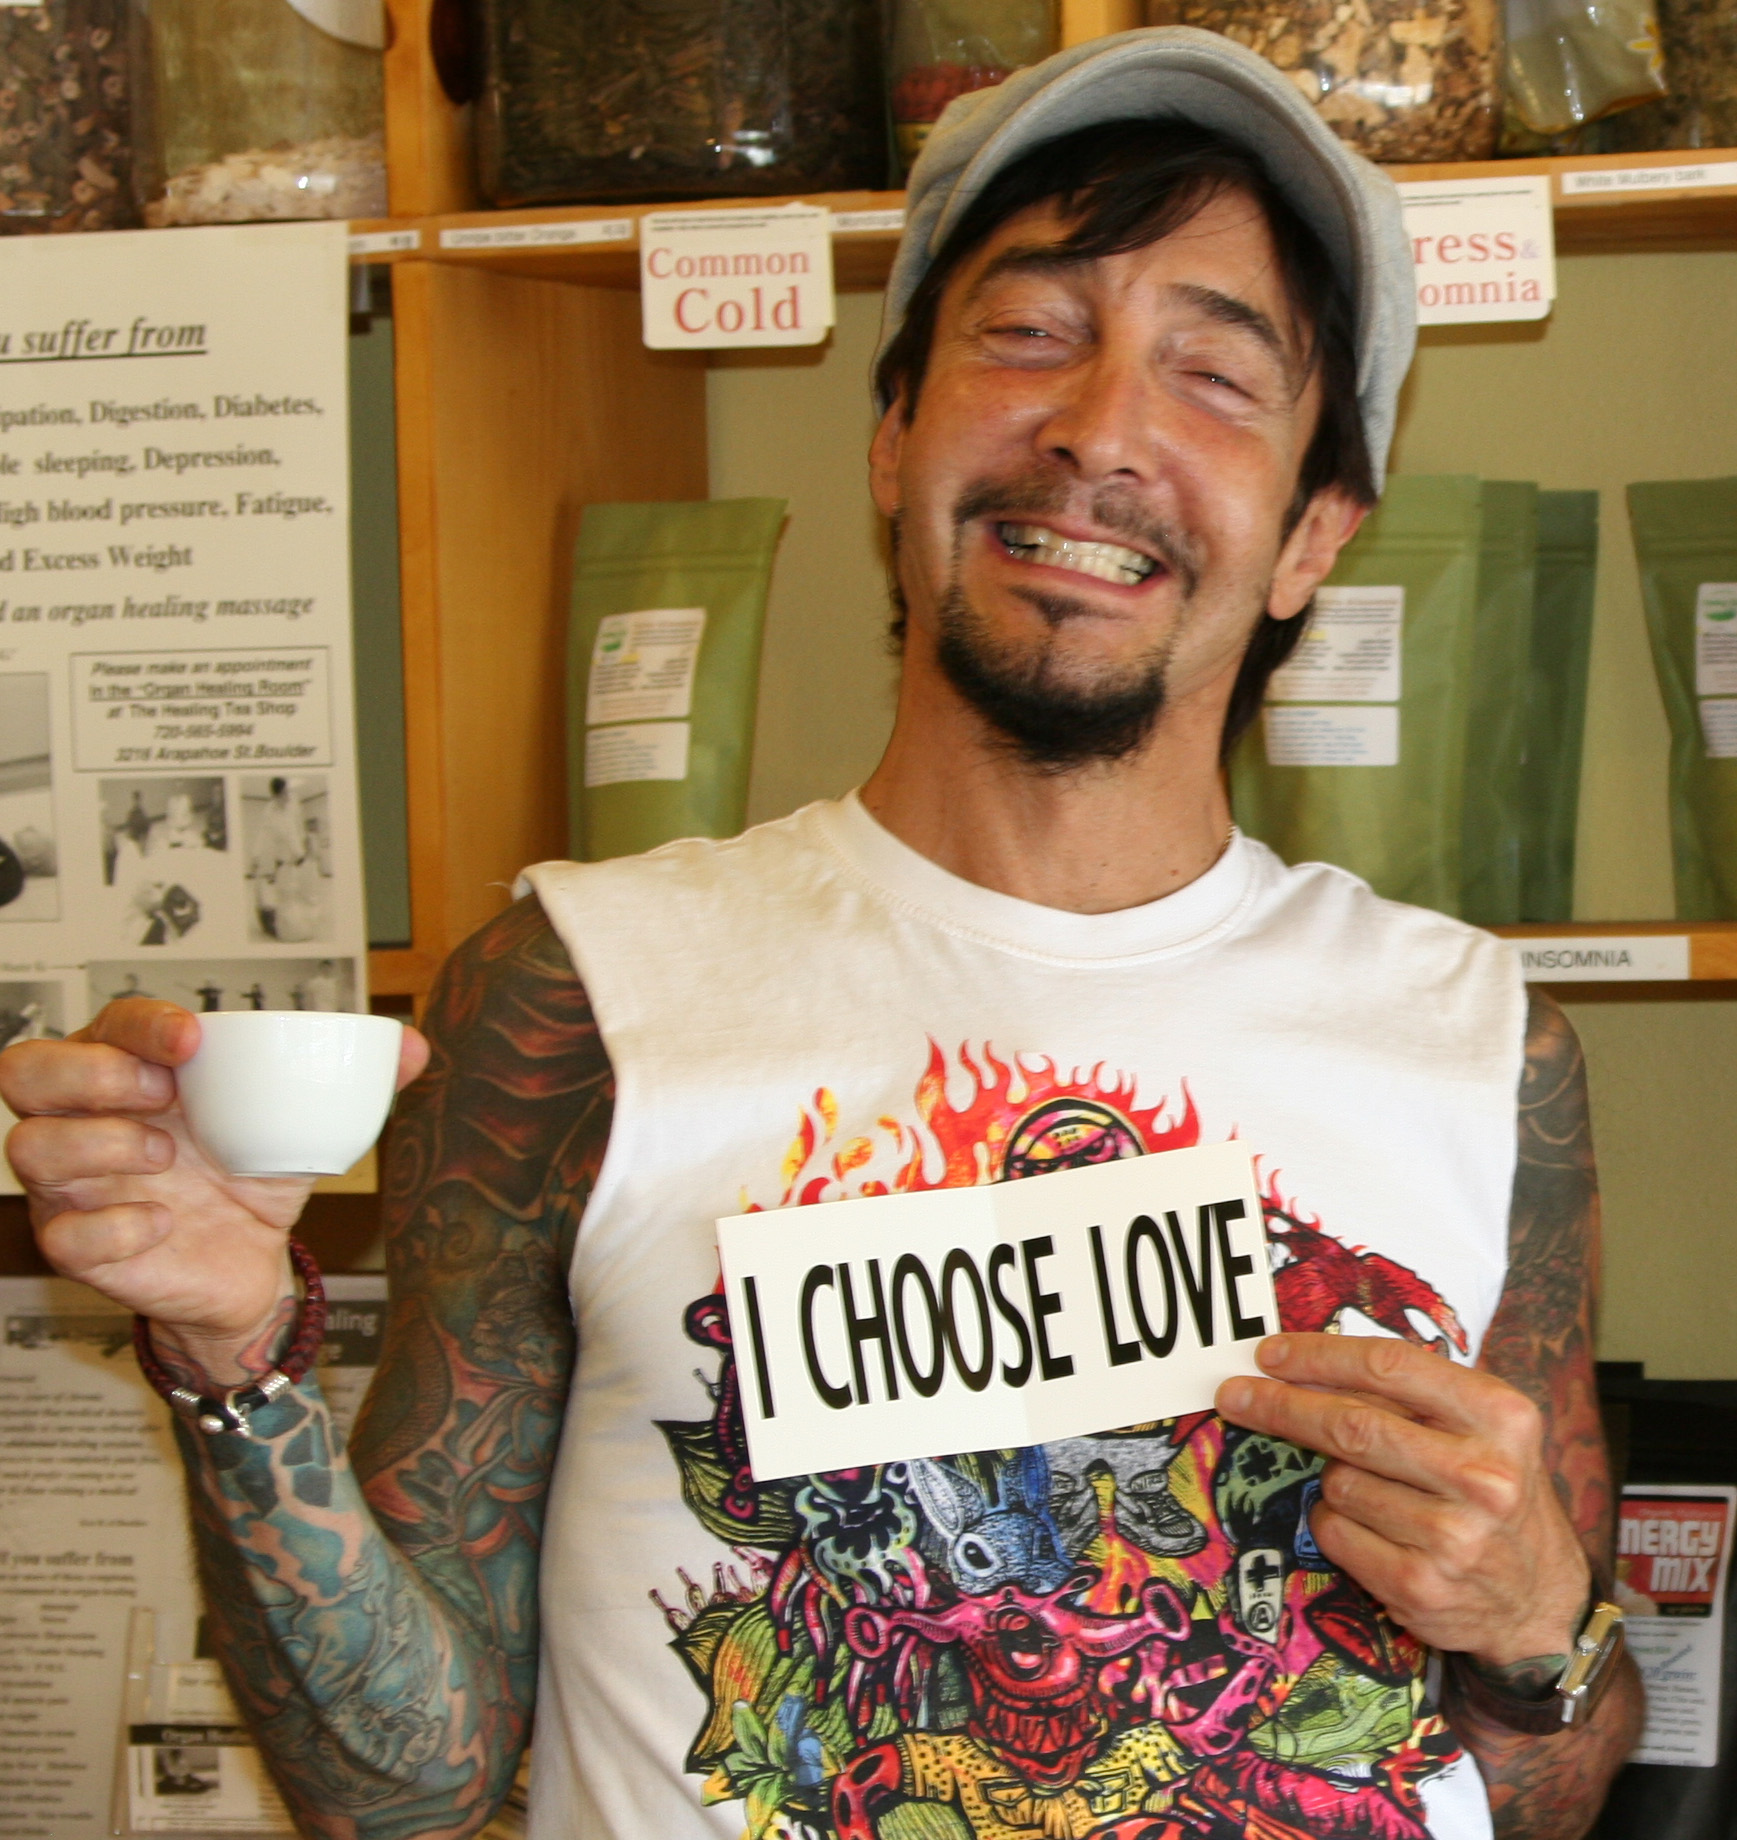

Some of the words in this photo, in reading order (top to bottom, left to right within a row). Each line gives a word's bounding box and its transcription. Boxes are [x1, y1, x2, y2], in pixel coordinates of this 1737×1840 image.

[647, 247, 810, 280] Common
[1413, 231, 1518, 264] ress
[1418, 271, 1540, 306] omnia
[674, 285, 802, 334] Cold
[22, 319, 118, 356] suffer
[128, 316, 206, 355] from
[89, 398, 205, 427] Digestion,
[213, 394, 323, 420] Diabetes,
[143, 444, 281, 472] Depression,
[47, 498, 112, 521] blood
[120, 497, 230, 525] pressure,
[236, 491, 333, 519] Fatigue,
[23, 548, 99, 571] Excess
[107, 542, 192, 571] Weight
[12, 606, 41, 622] an
[47, 604, 115, 627] organ
[122, 597, 208, 622] healing
[216, 598, 315, 619] massage
[1521, 951, 1631, 968] INSOMNIA
[741, 1276, 776, 1419] I
[797, 1234, 1076, 1411] CHOOSE
[1086, 1198, 1267, 1369] LOVE
[1650, 1557, 1717, 1592] MIX
